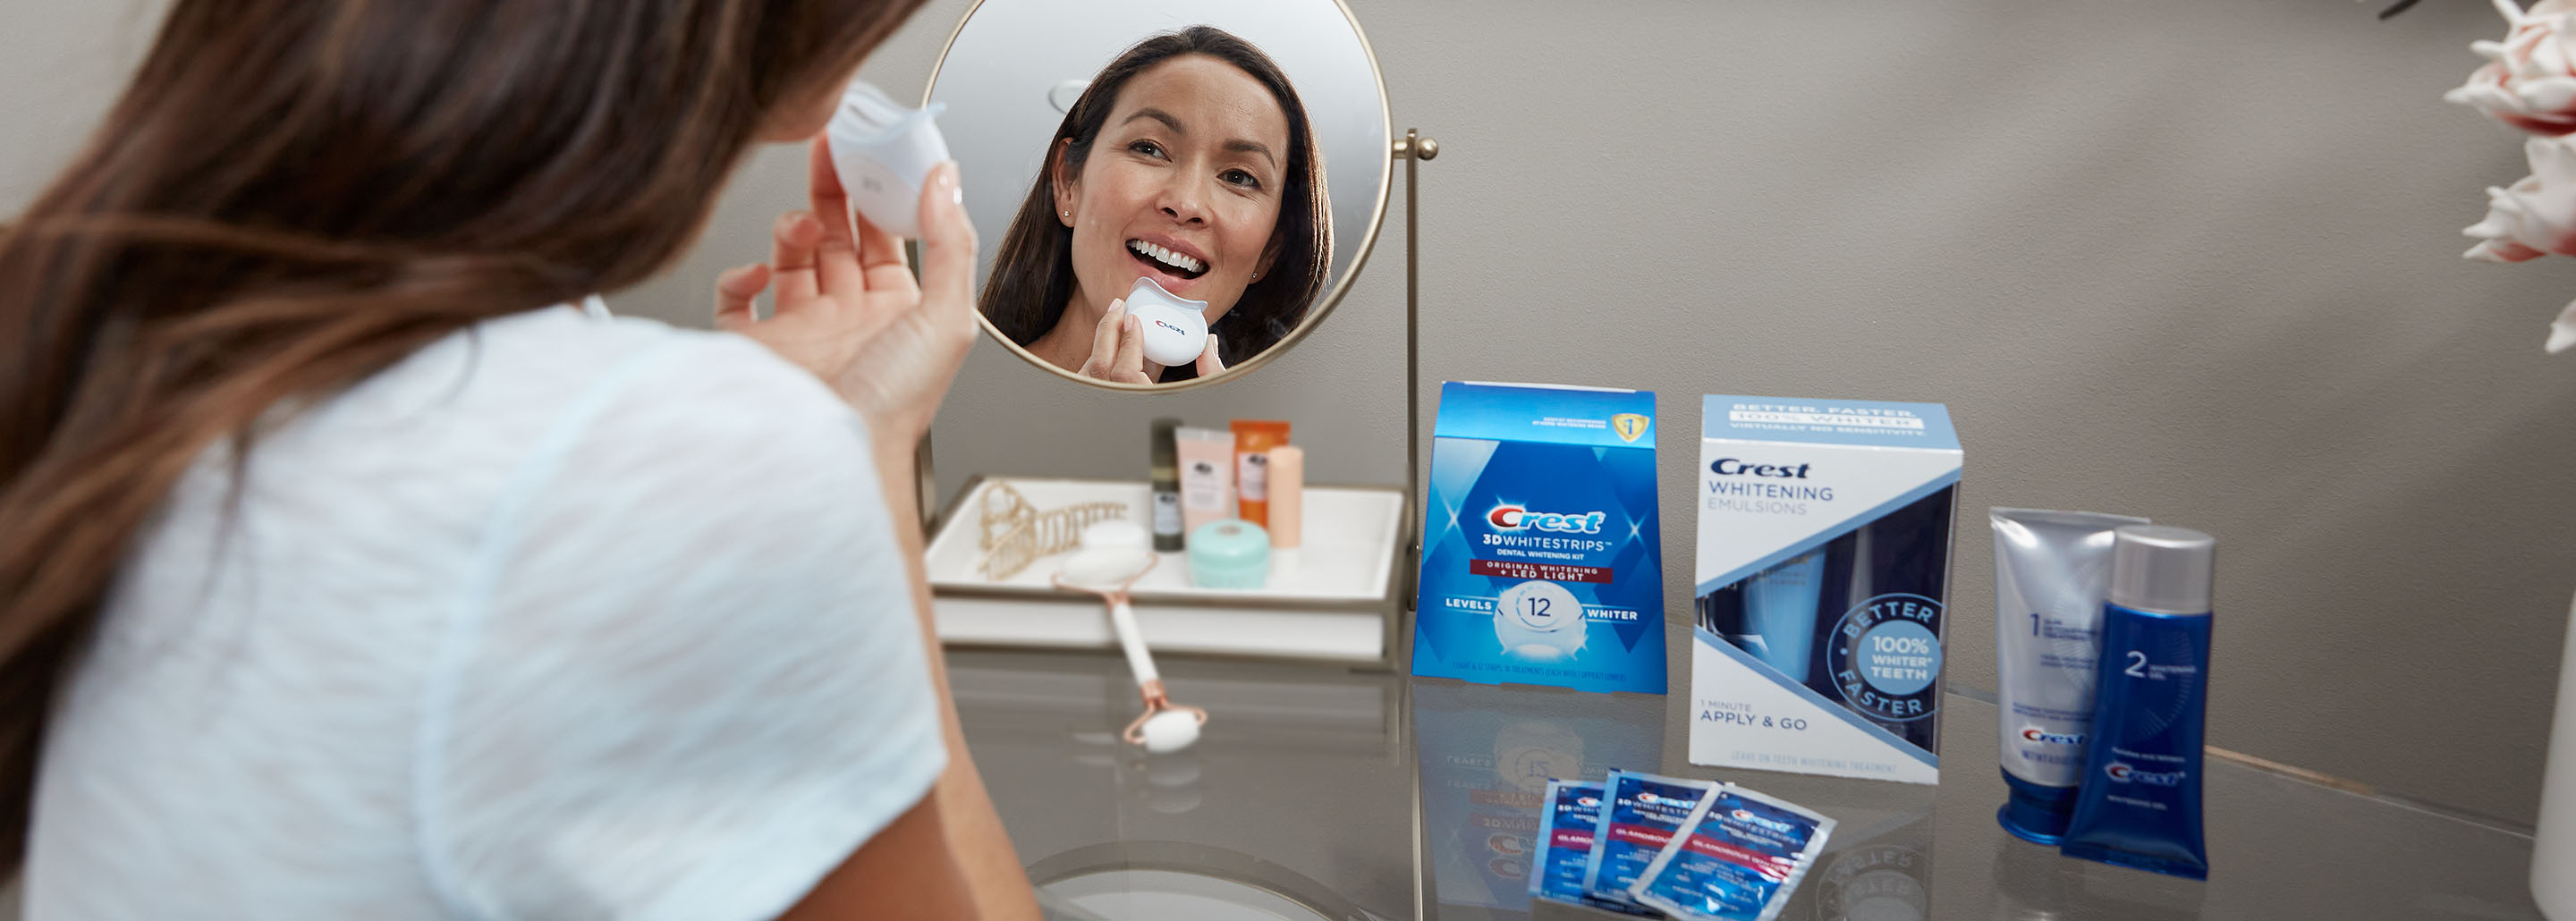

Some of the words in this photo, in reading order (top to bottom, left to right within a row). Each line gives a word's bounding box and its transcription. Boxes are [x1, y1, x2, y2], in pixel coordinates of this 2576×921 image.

[1710, 458, 1811, 479] Crest
[1708, 480, 1834, 502] WHITENING
[1707, 497, 1807, 515] EMULSIONS
[1487, 504, 1606, 534] Crest
[1496, 548, 1527, 557] DENTAL
[1528, 551, 1572, 561] WHITENING
[1487, 562, 1536, 570] ORIGINAL
[1539, 565, 1598, 575] WHITENING
[1512, 570, 1538, 579] LED
[1544, 571, 1585, 581] LIGHT
[1445, 598, 1492, 610] LEVELS
[1528, 597, 1551, 617] 12
[1587, 609, 1638, 621] WHITER
[1843, 601, 1935, 638] BETTER
[2029, 613, 2038, 637] 1
[1872, 636, 1929, 654] 100%
[1870, 666, 1928, 680] TEETH
[2124, 650, 2148, 678] 2
[1838, 669, 1923, 714] FASTER
[1708, 700, 1751, 712] MINUTE
[1700, 710, 1756, 725] APPLY
[1762, 715, 1773, 727] &
[1780, 718, 1807, 731] GO
[2021, 728, 2085, 745] Crest
